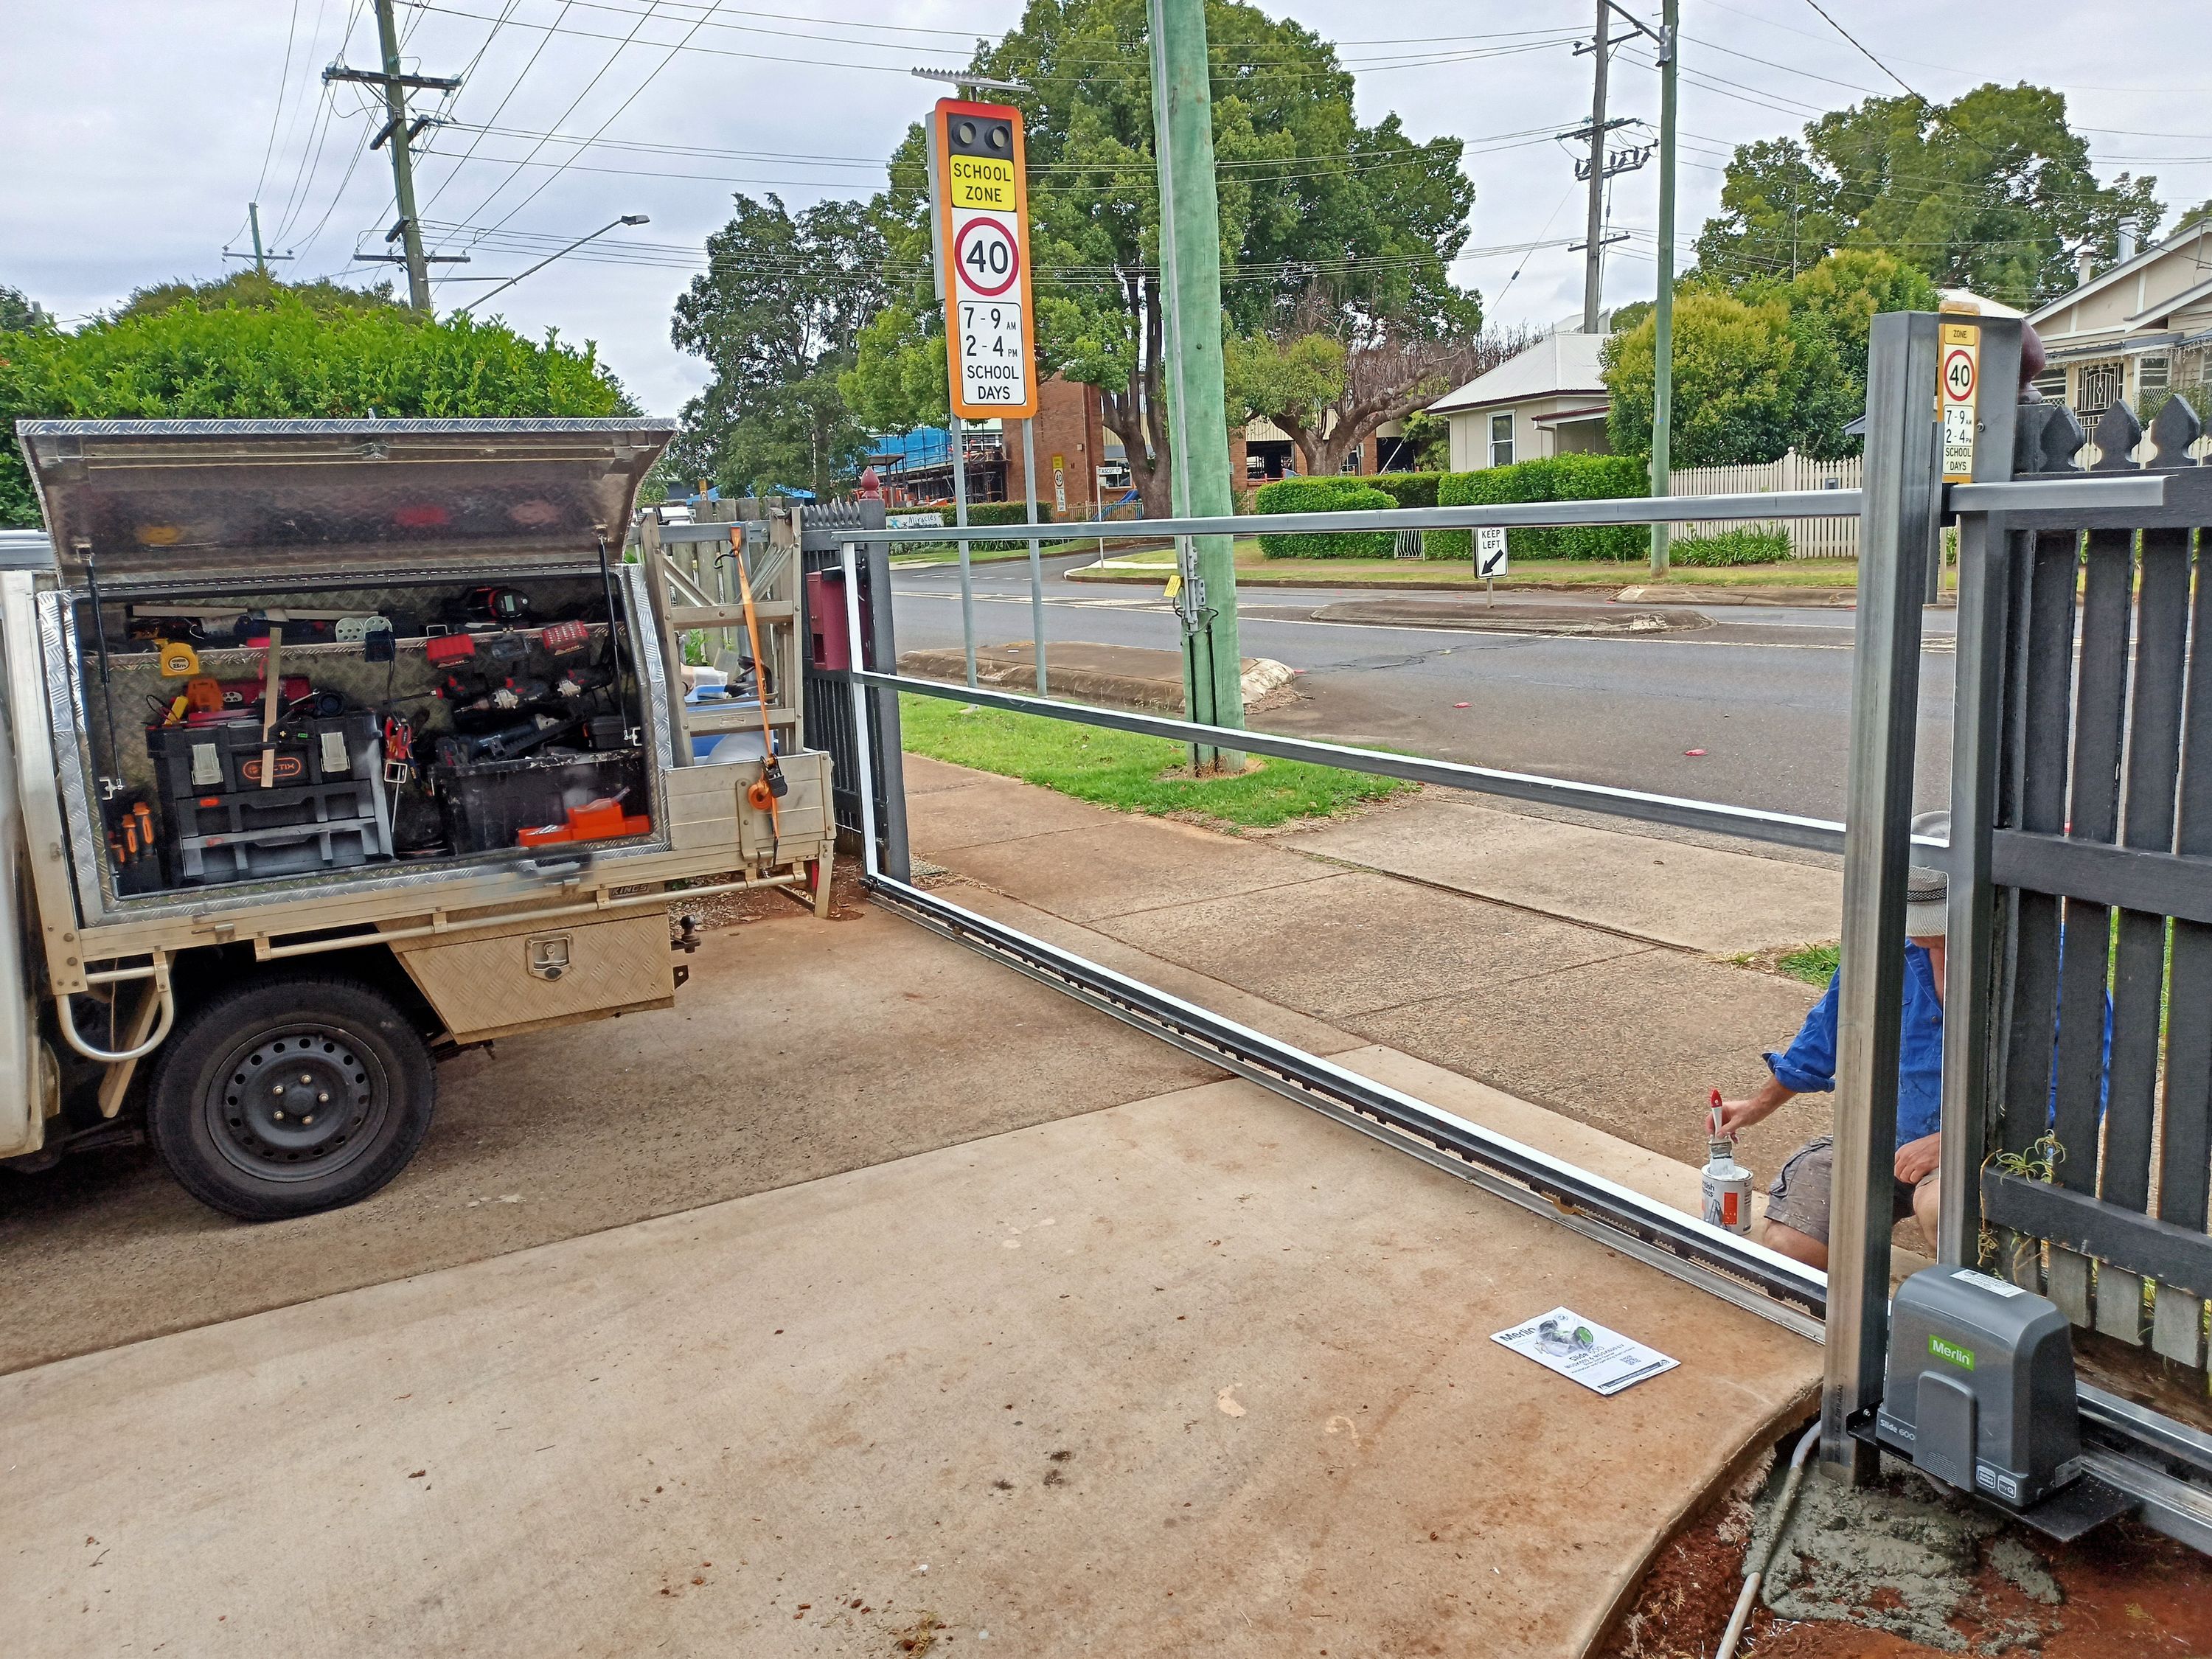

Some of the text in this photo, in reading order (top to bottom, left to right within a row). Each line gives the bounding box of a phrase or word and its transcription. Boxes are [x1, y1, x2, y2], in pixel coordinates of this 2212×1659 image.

[953, 162, 1012, 182] SCHOOL
[965, 185, 1002, 203] ZONE
[966, 240, 1008, 274] 40
[1006, 321, 1017, 330] AM
[1953, 330, 1967, 338] ZONE
[1008, 349, 1018, 358] PM
[967, 365, 1019, 380] SCHOOL
[1949, 364, 1970, 387] 40
[978, 386, 1010, 400] DAYS
[1945, 447, 1972, 457] SCHOOL
[1950, 461, 1966, 471] DAYS
[908, 515, 936, 524] Miracles
[1481, 529, 1500, 538] KEEP
[1483, 540, 1500, 549] LEFT
[612, 884, 649, 895] KINGS
[1499, 1327, 1536, 1342] Merlin
[1933, 1339, 1969, 1366] Merlin
[1879, 1419, 1916, 1441] Slide 600
